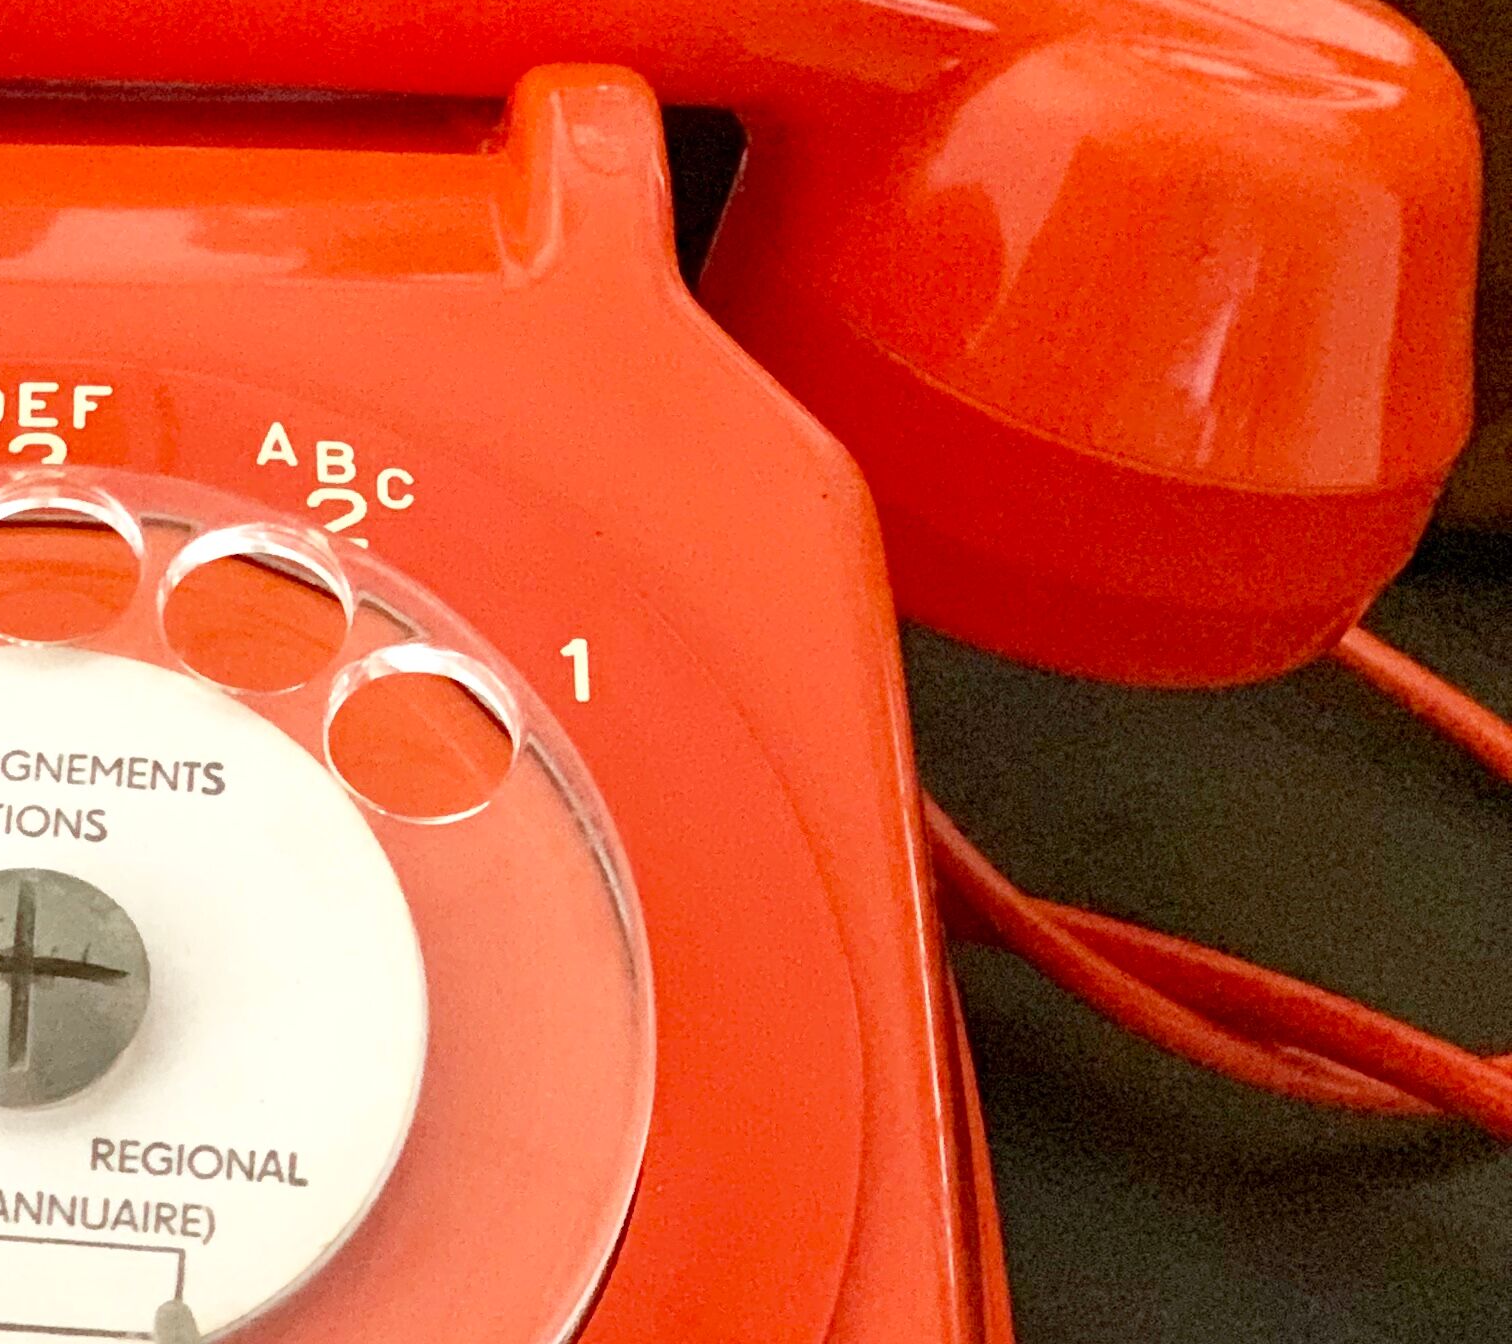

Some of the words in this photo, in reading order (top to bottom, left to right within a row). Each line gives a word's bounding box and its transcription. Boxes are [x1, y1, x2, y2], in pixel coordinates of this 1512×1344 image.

[256, 423, 414, 510] ABC
[560, 638, 590, 702] 1
[89, 1138, 308, 1187] REGIONAL
